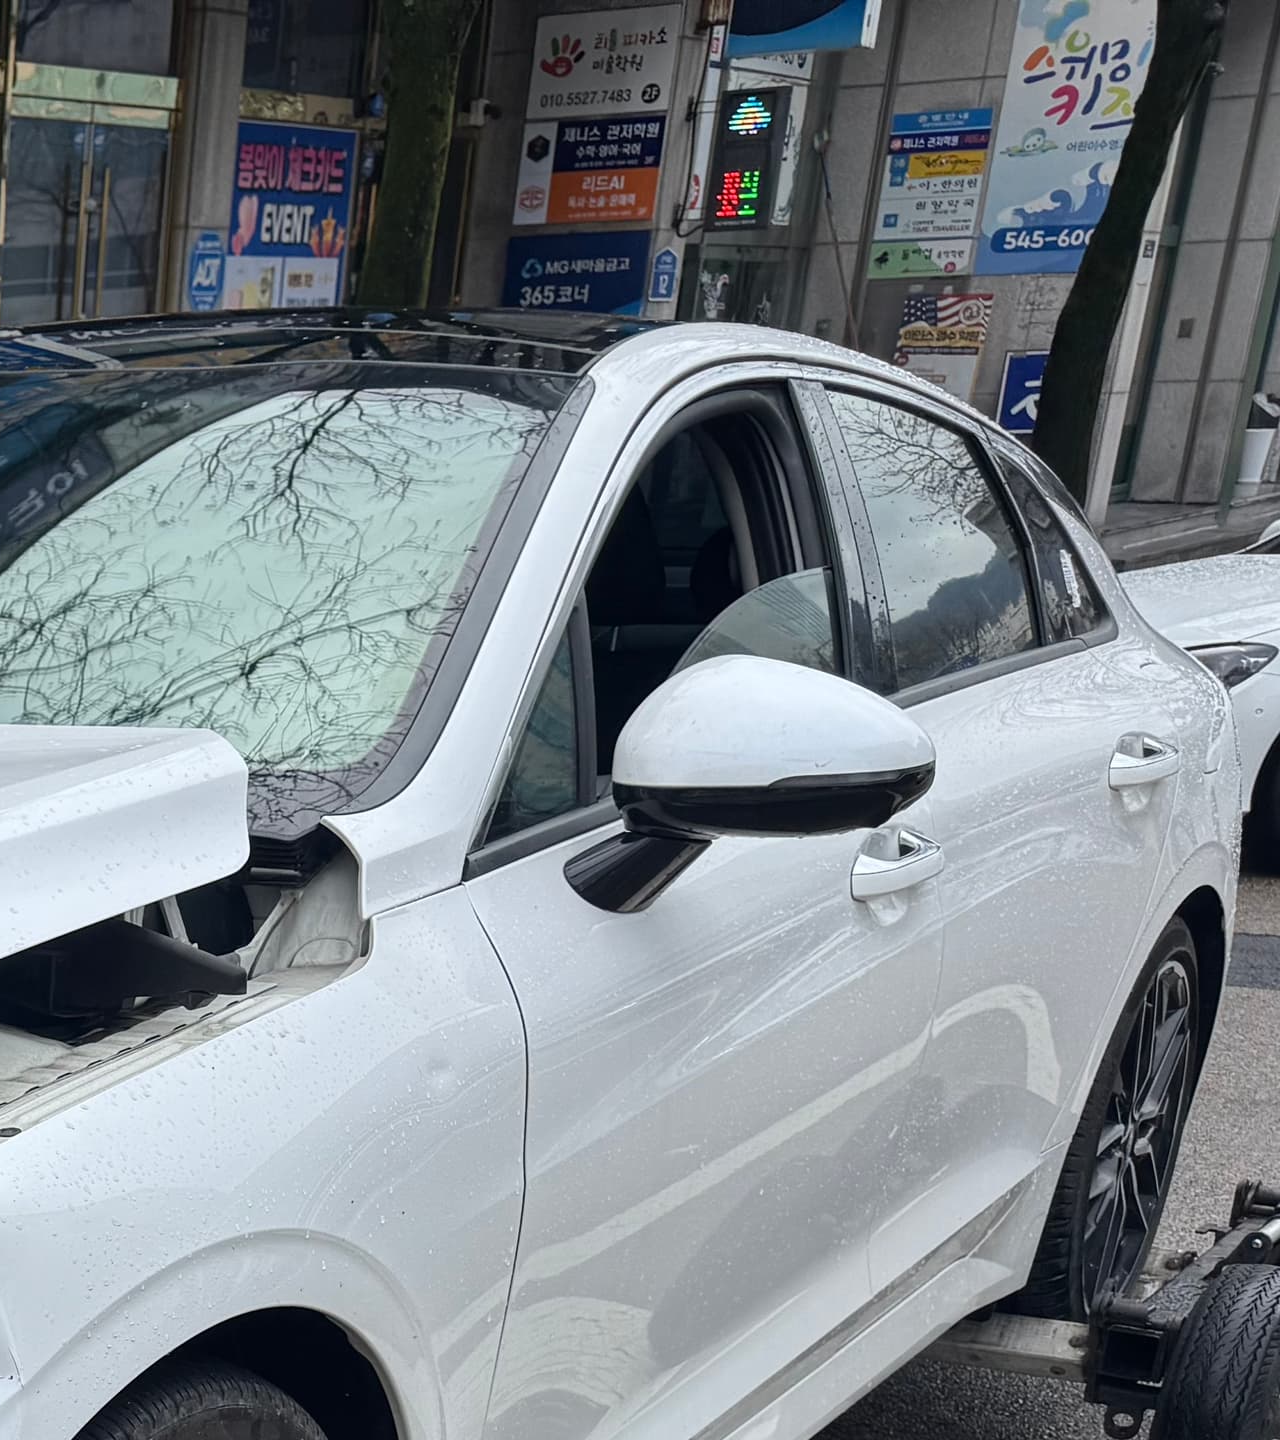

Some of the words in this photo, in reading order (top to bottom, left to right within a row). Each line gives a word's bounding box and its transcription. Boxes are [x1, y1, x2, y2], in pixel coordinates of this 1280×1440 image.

[623, 26, 667, 46] 피카소
[592, 53, 643, 74] 미술학원
[1024, 30, 1131, 84] 스위밍
[540, 88, 632, 108] 010.5527.7483
[1044, 74, 1134, 130] 키즈
[563, 127, 601, 142] 제니스
[607, 122, 660, 140] 관저학원
[238, 144, 285, 191] 봄맞이
[286, 148, 346, 193] 체크카드
[582, 175, 625, 193] 리드AI
[260, 203, 315, 243] EVENT
[192, 258, 222, 288] ADT
